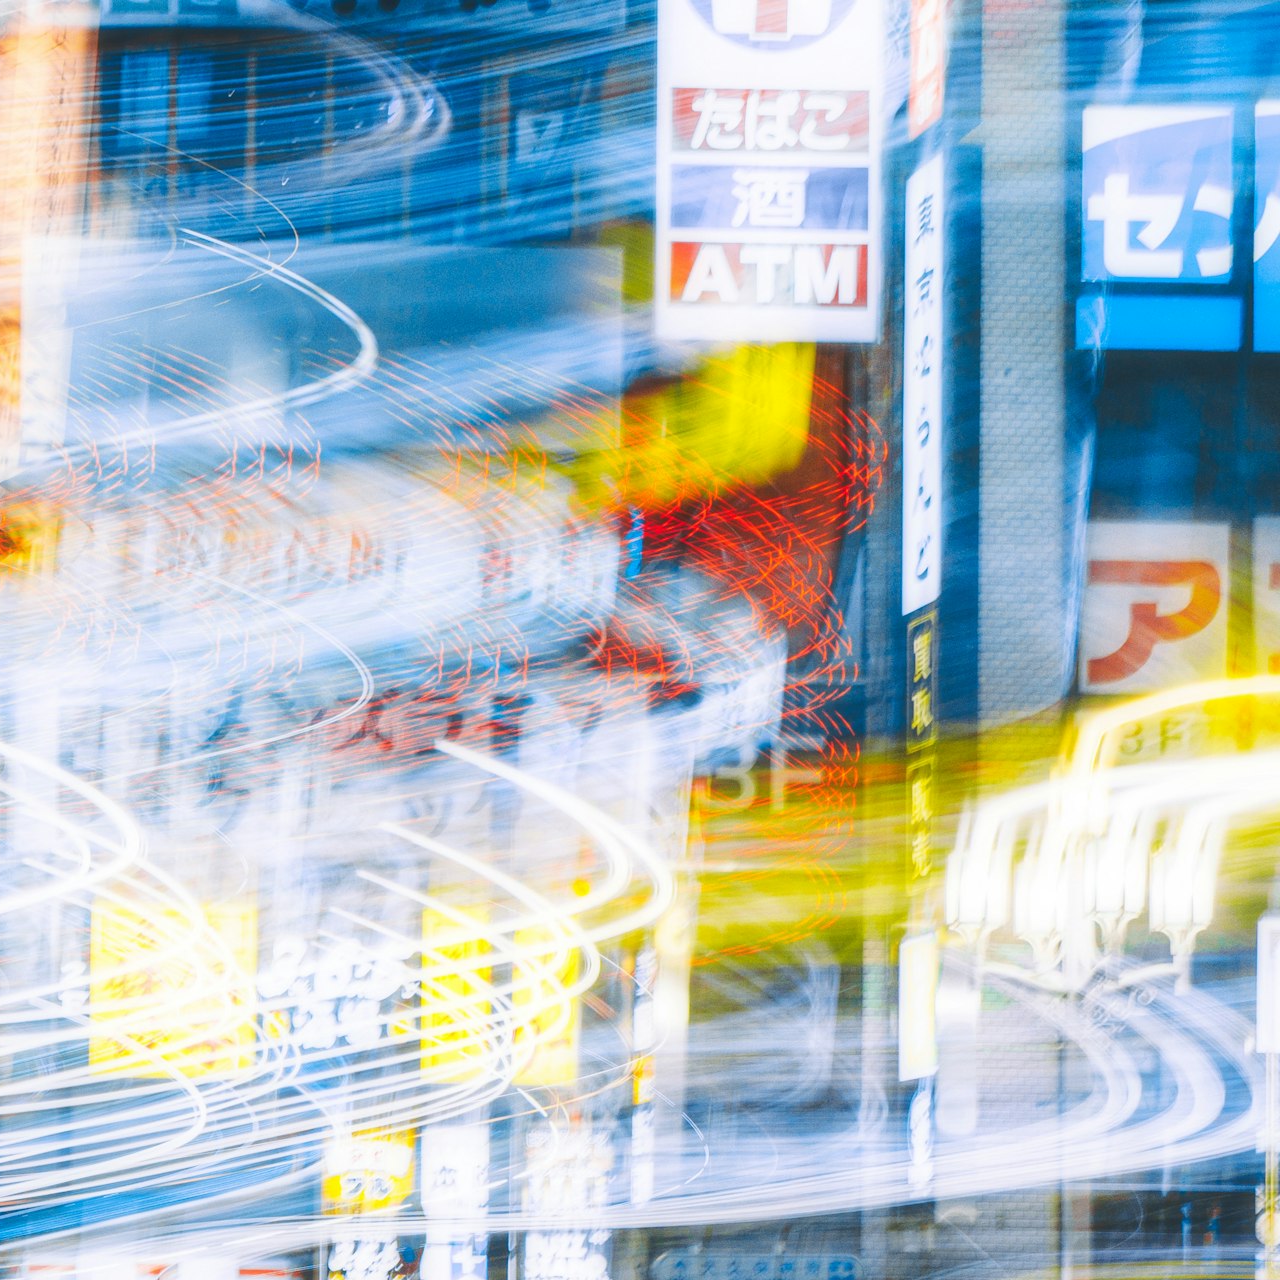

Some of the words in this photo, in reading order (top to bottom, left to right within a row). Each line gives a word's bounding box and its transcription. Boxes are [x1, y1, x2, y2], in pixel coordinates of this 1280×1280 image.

[691, 88, 850, 150] たばこ
[731, 168, 809, 228] 酒
[680, 243, 859, 304] ATM
